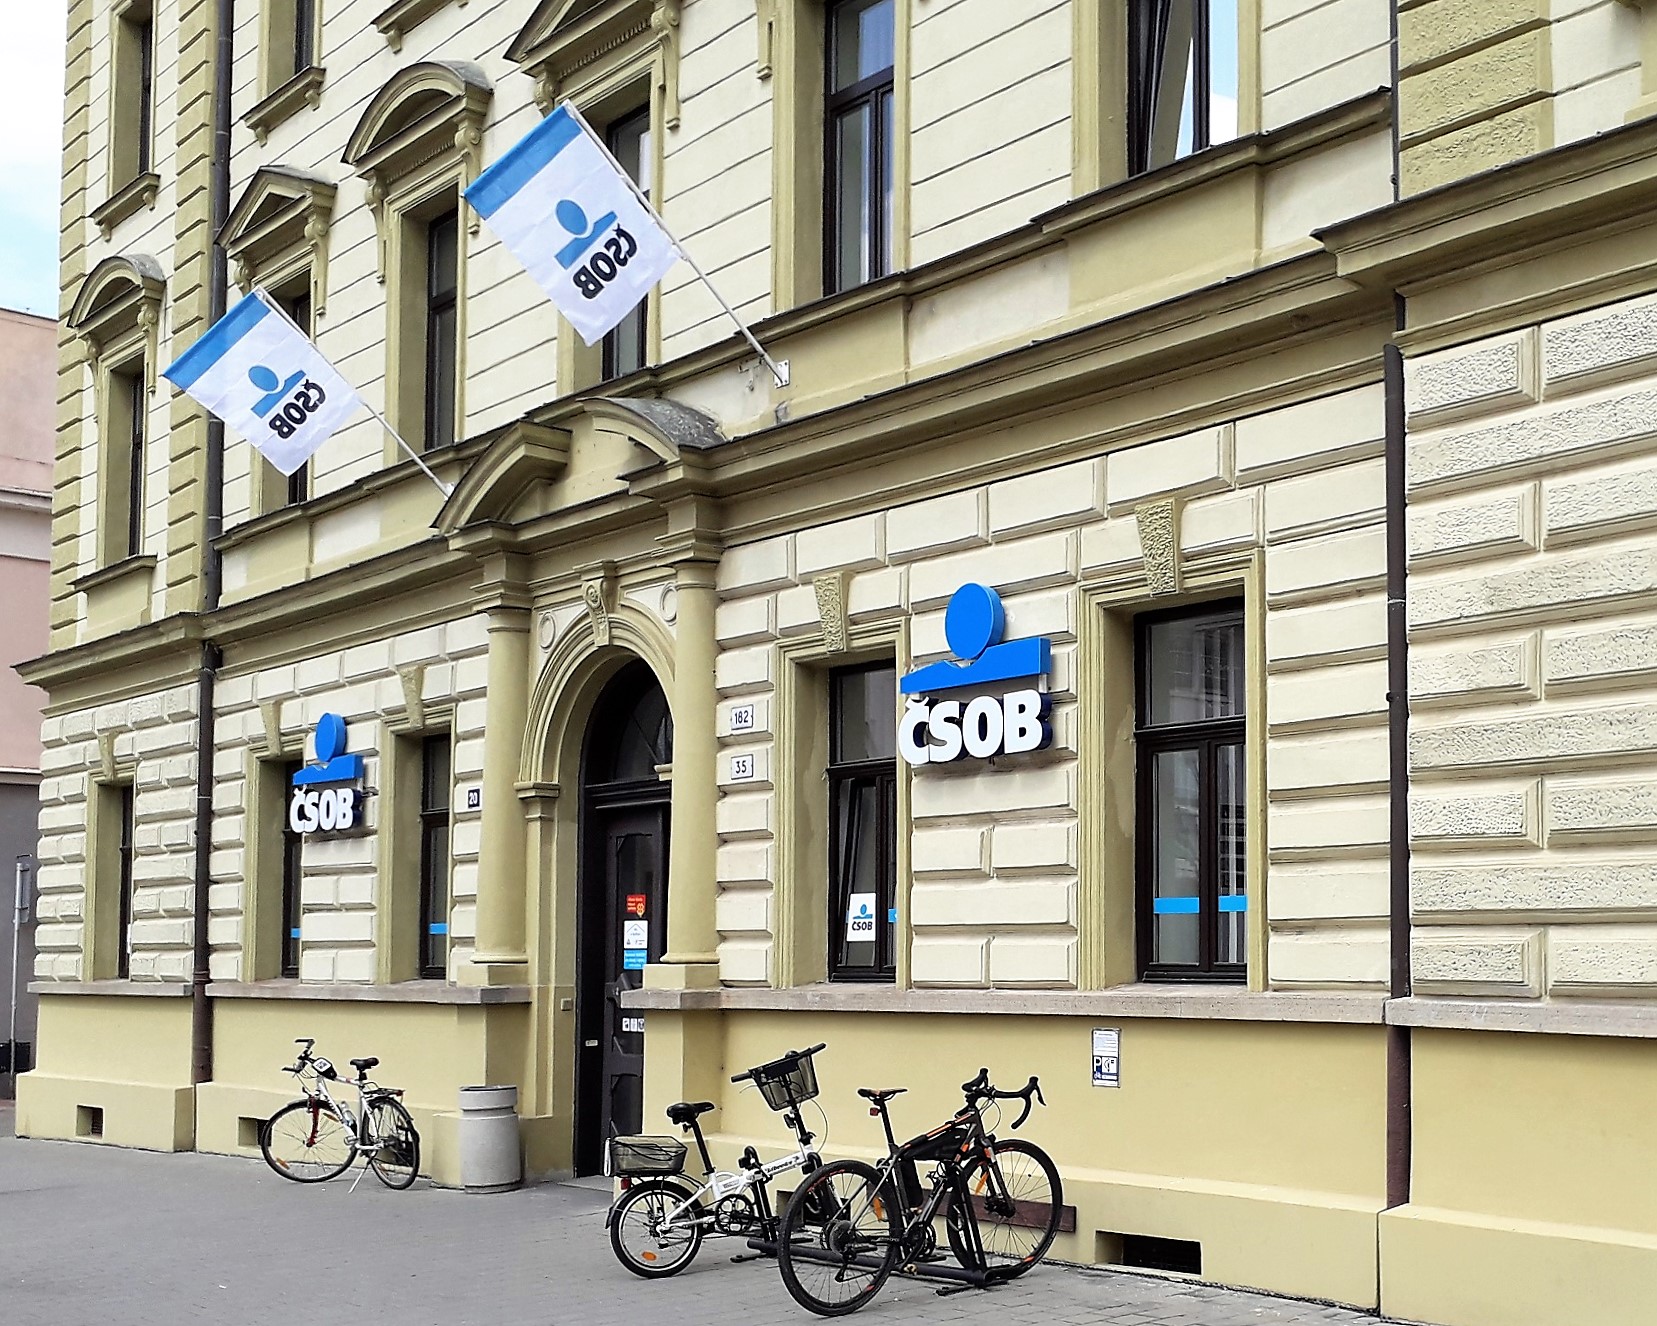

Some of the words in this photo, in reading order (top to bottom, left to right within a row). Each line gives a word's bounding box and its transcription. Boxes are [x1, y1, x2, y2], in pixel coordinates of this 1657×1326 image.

[734, 709, 749, 725] 182
[898, 696, 1043, 765] ČSOB
[735, 760, 747, 774] 35
[289, 785, 354, 833] ČSOB
